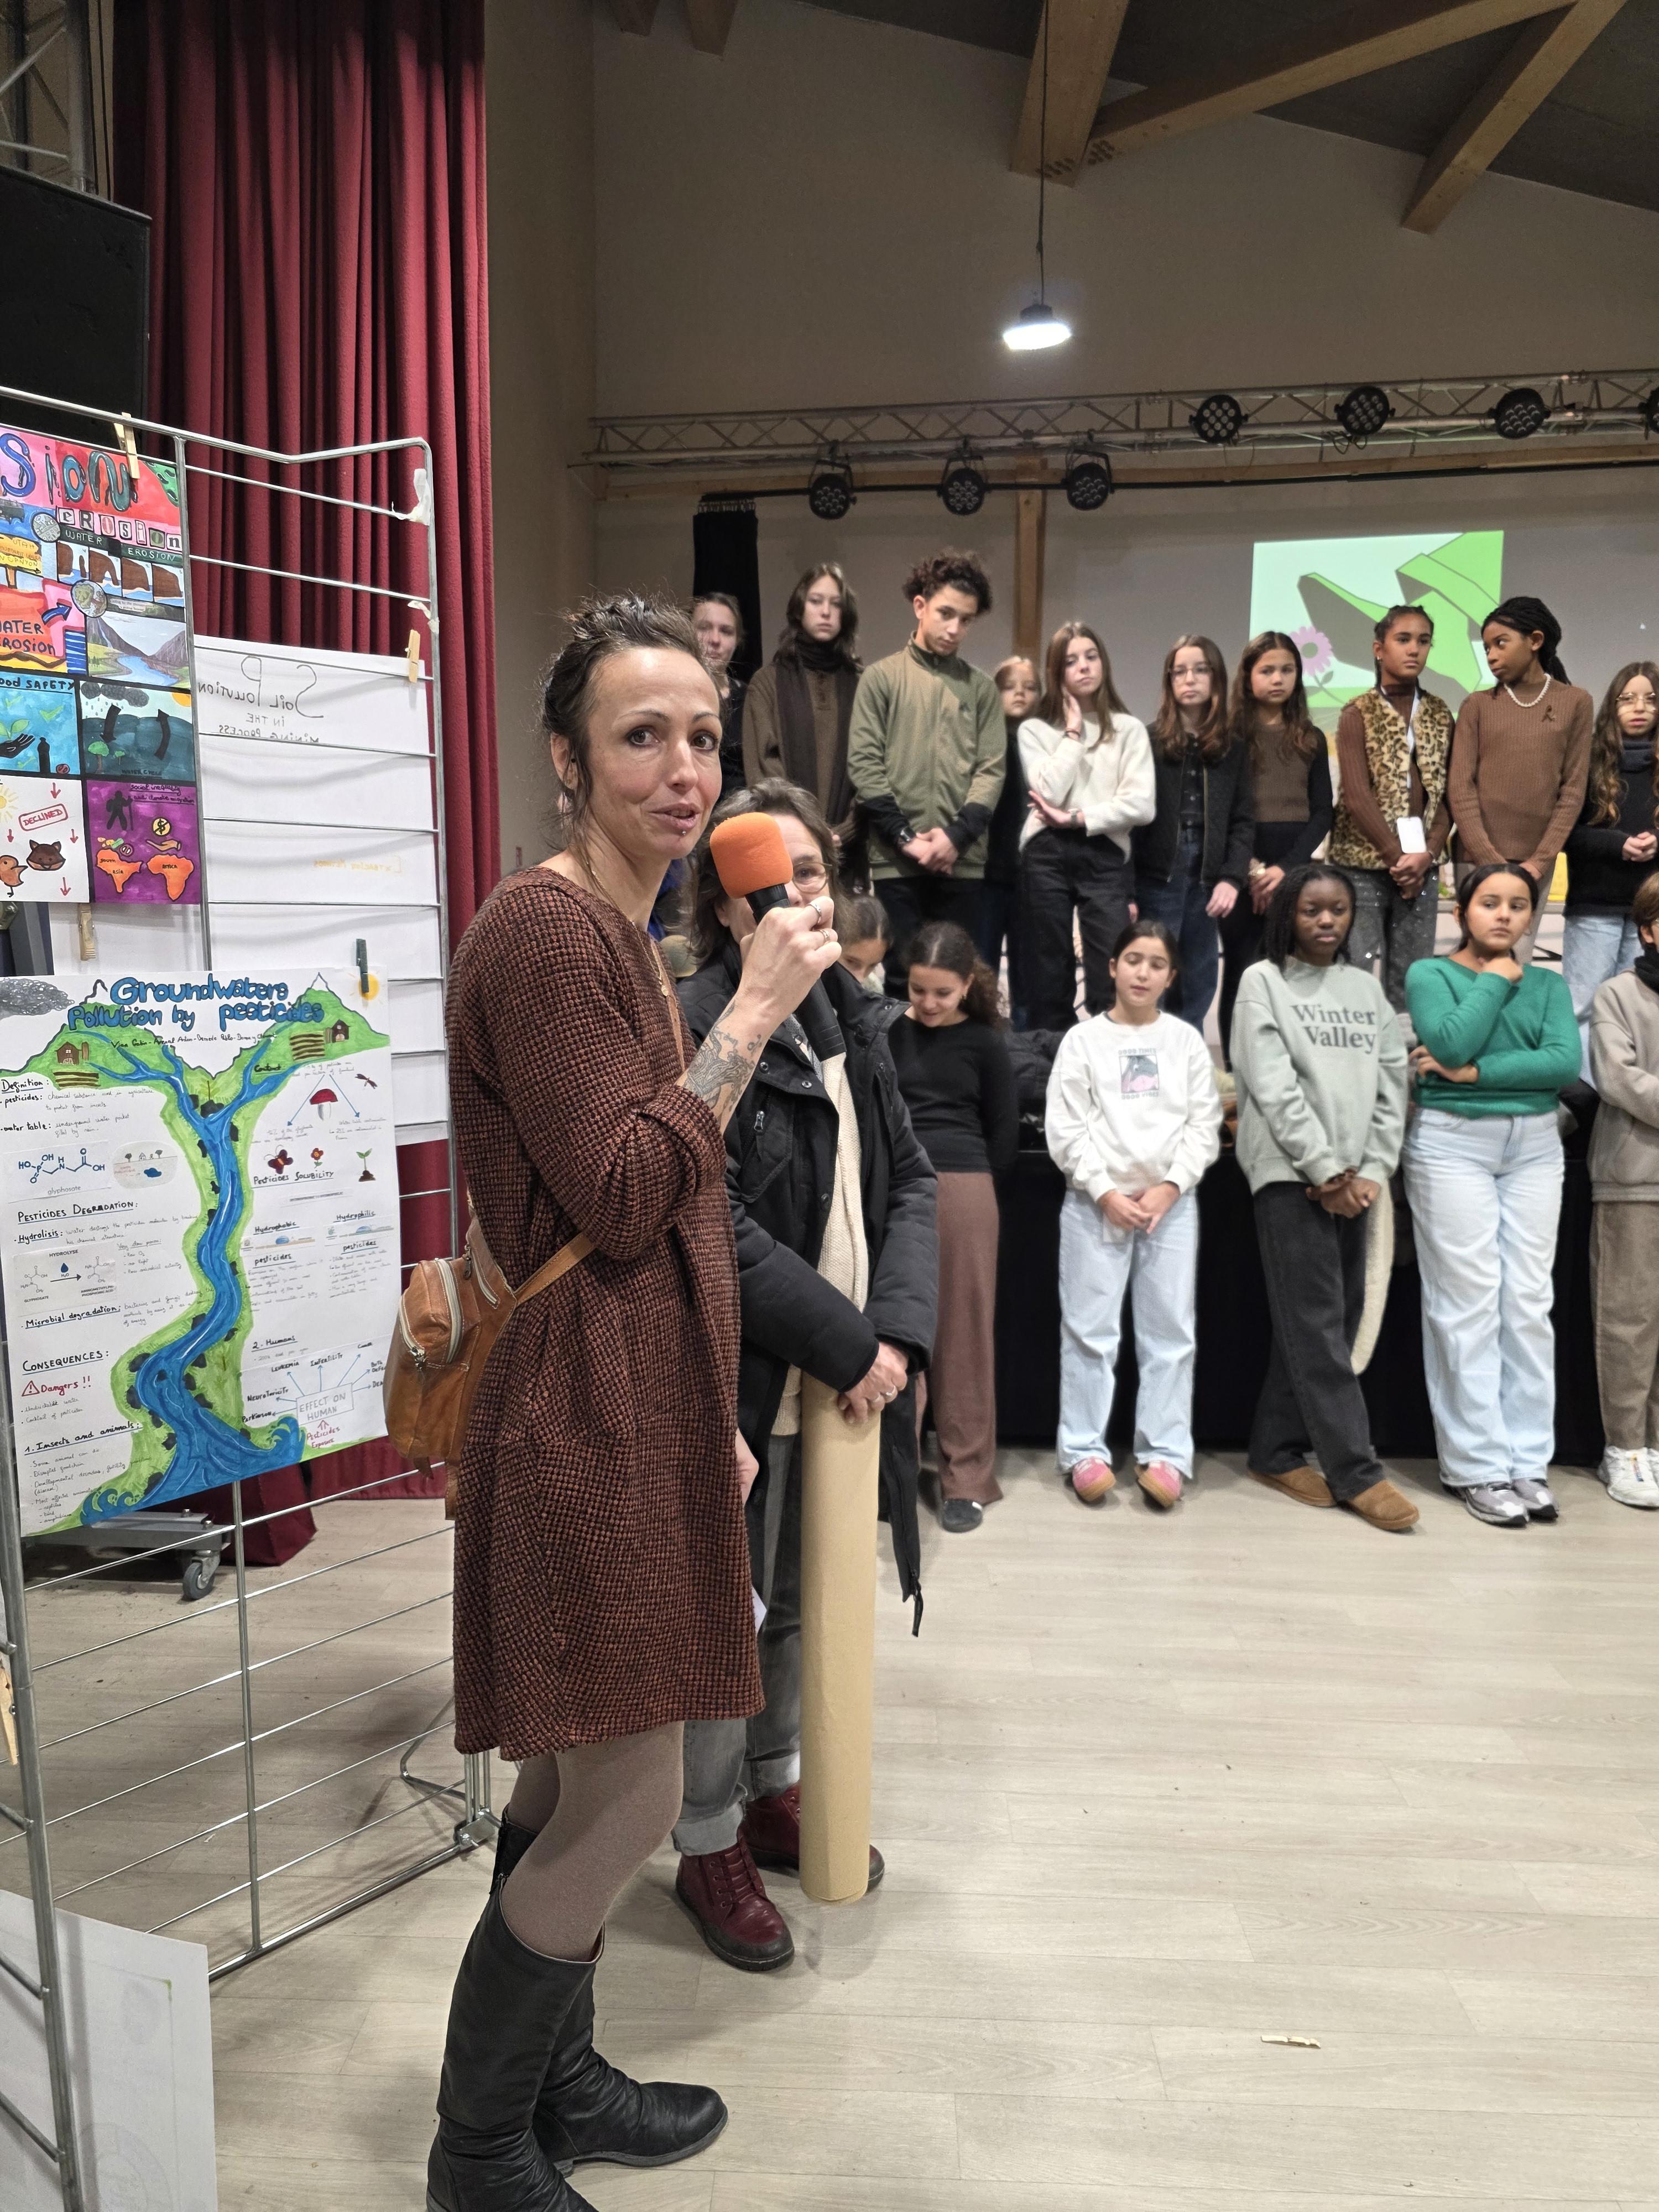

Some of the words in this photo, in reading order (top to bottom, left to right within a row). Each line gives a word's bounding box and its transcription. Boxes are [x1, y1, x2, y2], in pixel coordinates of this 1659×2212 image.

[13, 539, 35, 549] UTAH
[65, 530, 103, 545] WATER
[8, 556, 38, 566] CANYON
[0, 620, 44, 634] ATER
[26, 680, 75, 690] SAFETY
[23, 808, 63, 826] DECLINED
[110, 973, 289, 1005] Groundwaters
[67, 1004, 163, 1031] Pollution
[172, 1004, 196, 1032] by
[219, 1001, 325, 1032] pesticides
[1290, 1004, 1375, 1025] Winter
[1302, 1026, 1376, 1054] Valley
[48, 1185, 81, 1196] glyphosate
[49, 1249, 79, 1258] HYDROLYSE
[26, 1313, 65, 1327] Microbial
[40, 1381, 79, 1396] Dangers
[299, 1396, 330, 1413] EFFECT
[333, 1392, 346, 1404] ON
[307, 1406, 338, 1421] HUMAN
[36, 1437, 70, 1451] Insects
[75, 1431, 94, 1441] and
